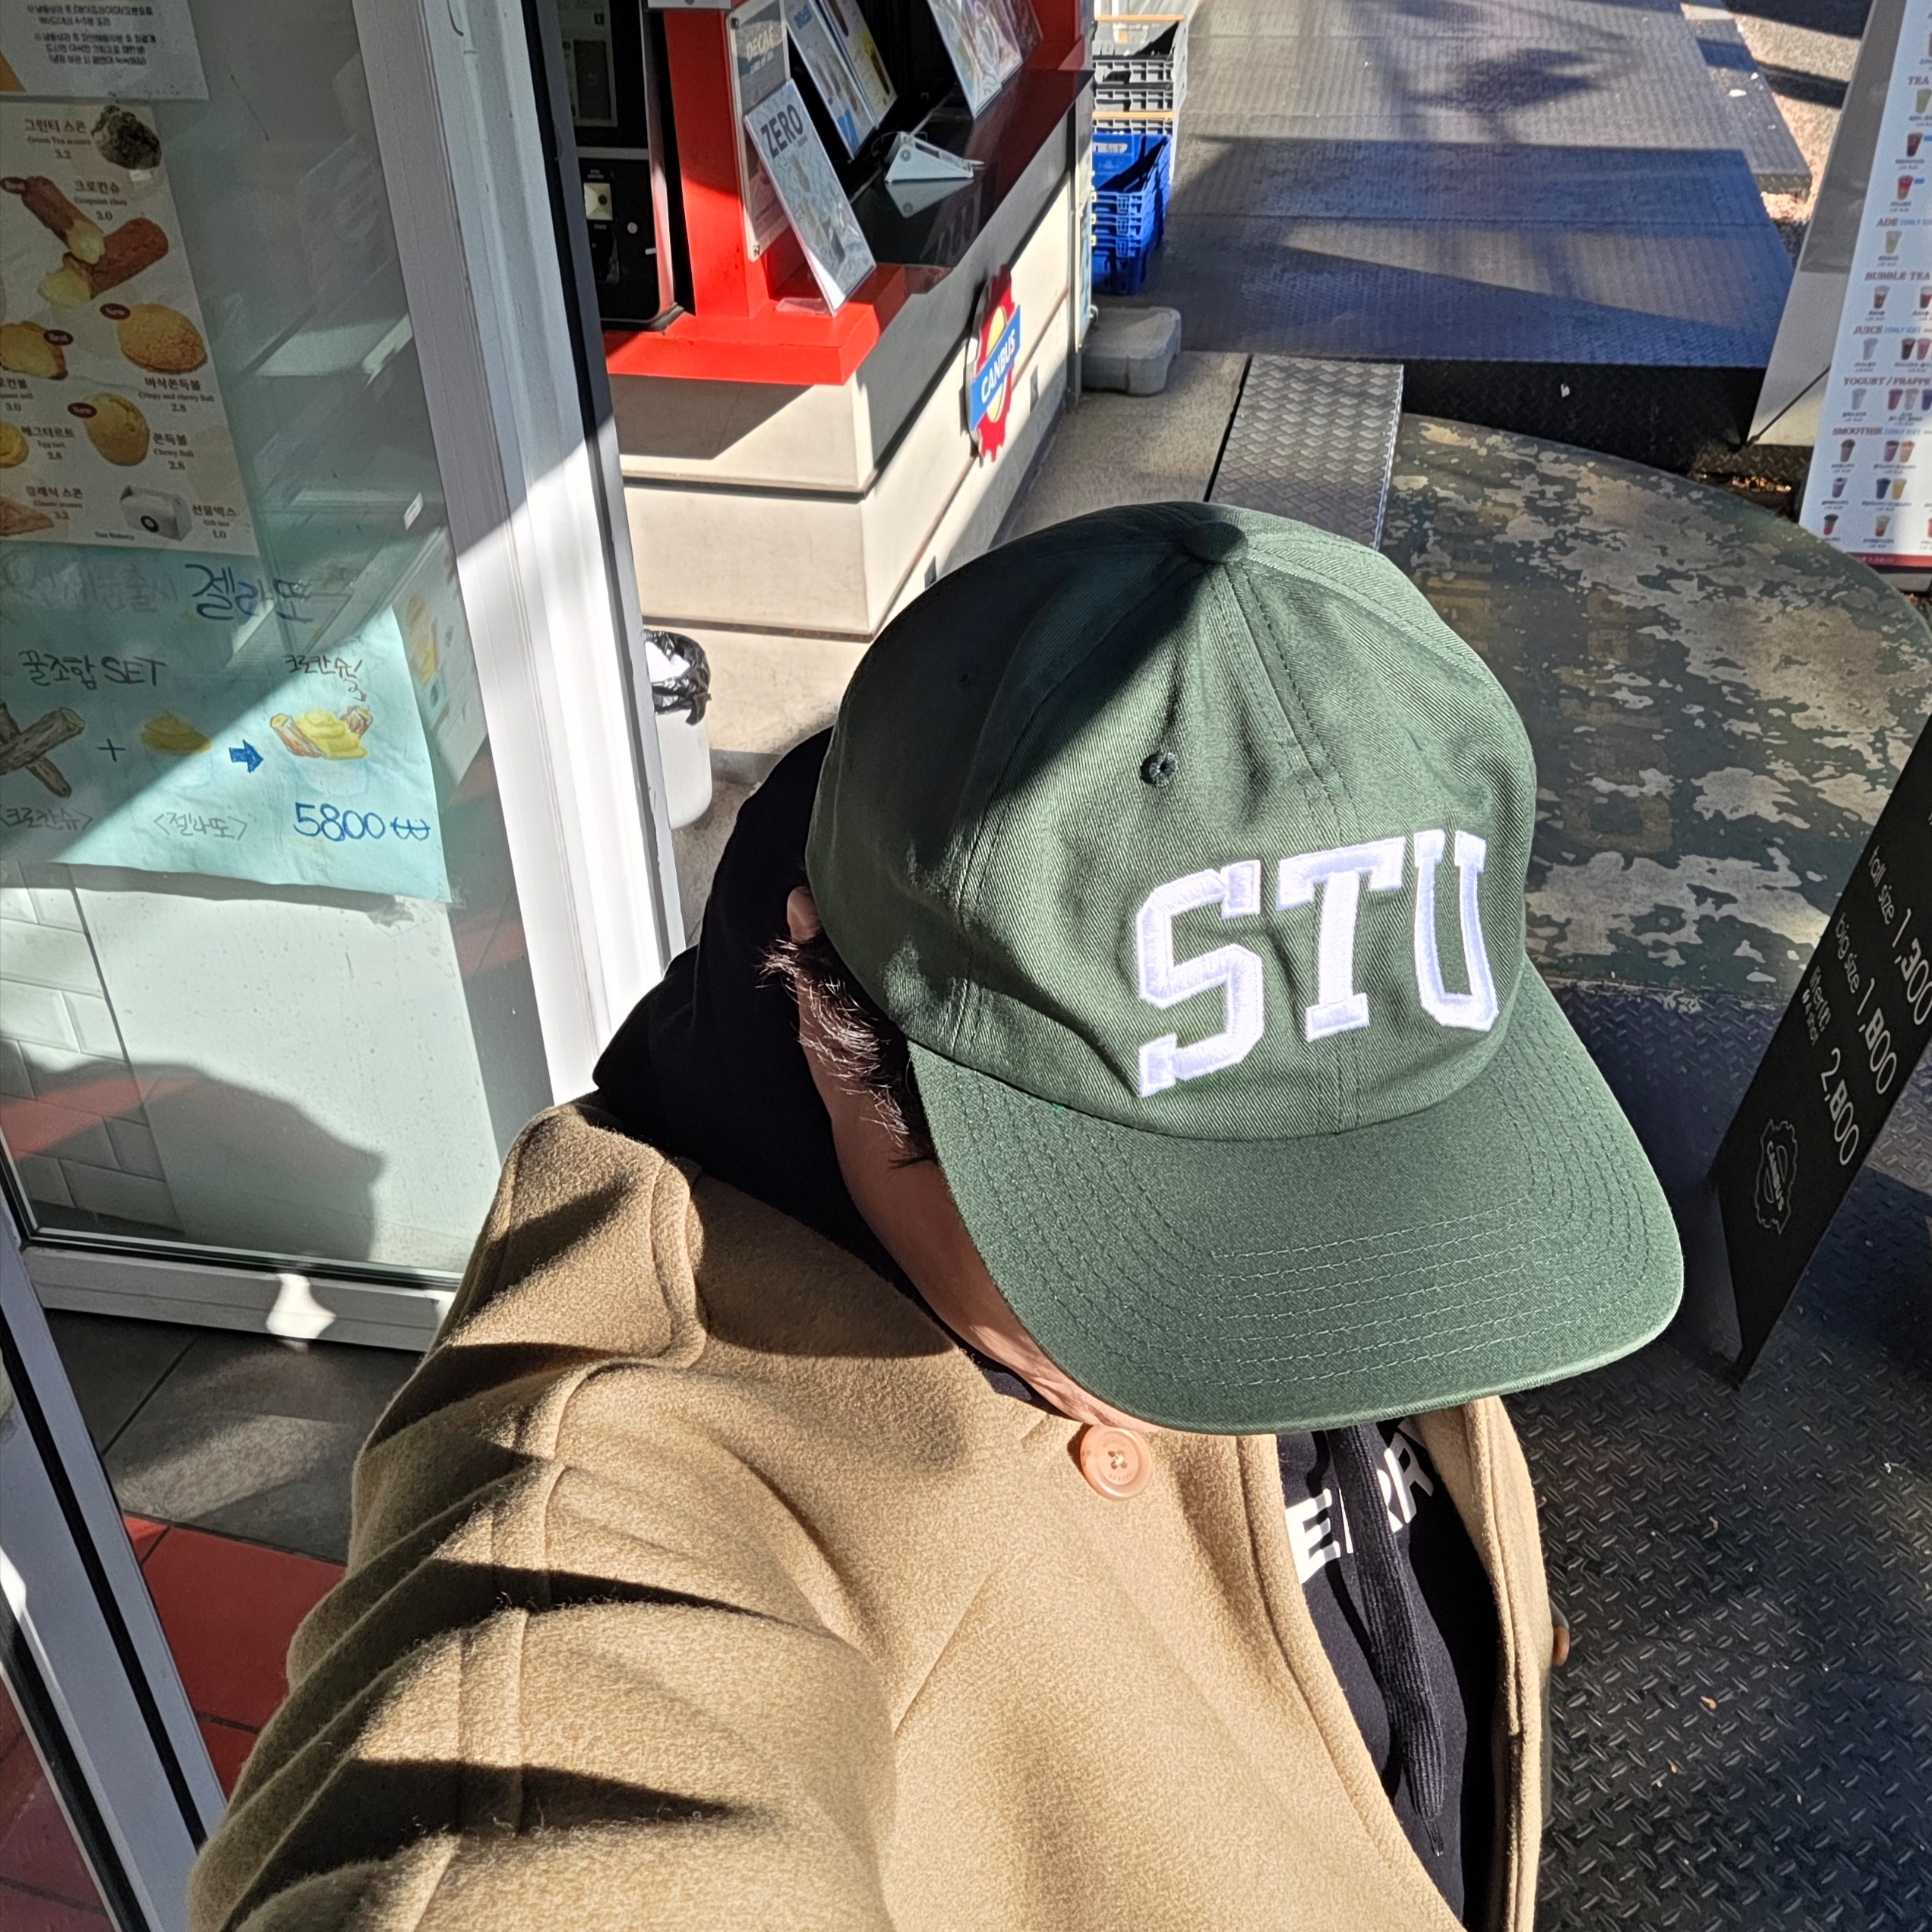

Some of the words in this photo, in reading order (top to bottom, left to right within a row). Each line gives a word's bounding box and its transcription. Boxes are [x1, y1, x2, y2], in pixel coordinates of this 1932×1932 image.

[1907, 76, 1930, 86] TEA
[24, 118, 61, 133] 그린티
[64, 119, 87, 133] 스콘
[760, 103, 803, 159] ZERO
[1876, 217, 1899, 228] ADE
[1864, 270, 1907, 282] BUBBLE
[1908, 272, 1930, 282] TEA
[1852, 326, 1883, 336] JUICE
[980, 327, 1016, 404] CANBUS
[1842, 376, 1887, 387] YOGURT
[171, 403, 188, 413] 2.8
[1832, 427, 1883, 437] SMOOTHIE
[168, 459, 186, 470] 2.8
[191, 504, 238, 517] 선물박스
[18, 649, 98, 690] 꿀조합
[99, 655, 168, 687] SET
[1869, 844, 1888, 889] tall
[1877, 879, 1896, 927] size
[1833, 912, 1852, 962] big
[1136, 828, 1500, 1099] STU
[1840, 952, 1861, 994] size
[1855, 977, 1897, 1094] 1,800
[1820, 1046, 1859, 1166] 2,800
